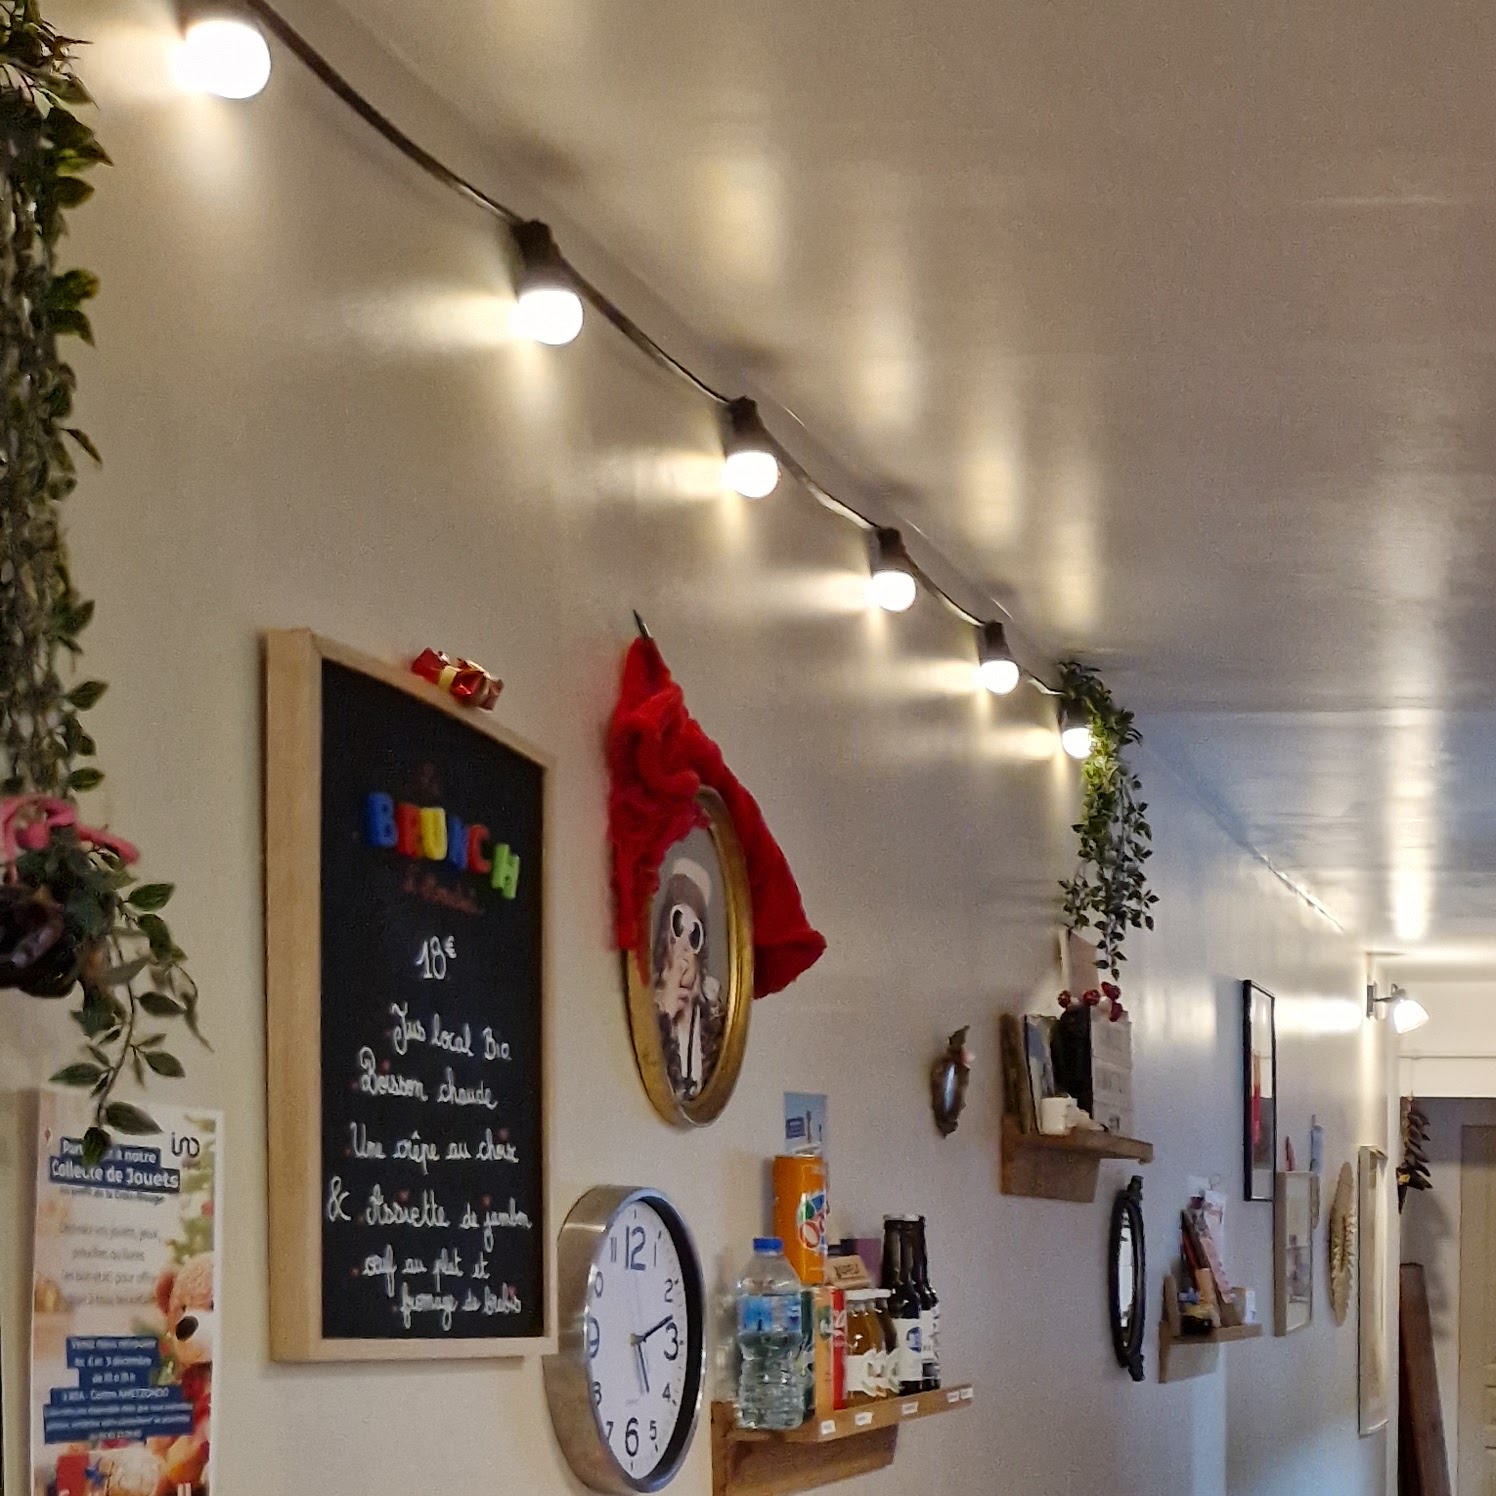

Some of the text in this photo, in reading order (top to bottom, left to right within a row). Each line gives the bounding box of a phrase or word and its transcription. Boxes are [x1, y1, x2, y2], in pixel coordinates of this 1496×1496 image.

[366, 792, 520, 899] BRUNCH
[390, 1002, 426, 1055] Jus
[431, 1012, 474, 1057] local
[359, 1045, 498, 1110] Boisson chaude
[124, 1150, 157, 1164] notre
[350, 1121, 387, 1160] Une
[391, 1129, 441, 1175] crêpe
[445, 1141, 473, 1160] au
[105, 1165, 124, 1183] de
[126, 1167, 179, 1188] Jouets
[365, 1183, 451, 1228] Assiette
[458, 1202, 480, 1229] de
[482, 1196, 533, 1253] jambon
[624, 1225, 647, 1271] 12
[402, 1257, 428, 1275] au
[431, 1247, 465, 1292] plat
[471, 1251, 491, 1279] et
[663, 1277, 674, 1302] 2
[662, 1321, 680, 1361] 3
[661, 1382, 672, 1401] 4
[605, 1420, 615, 1446] 7
[624, 1417, 640, 1457] 6
[649, 1419, 658, 1441] 5
